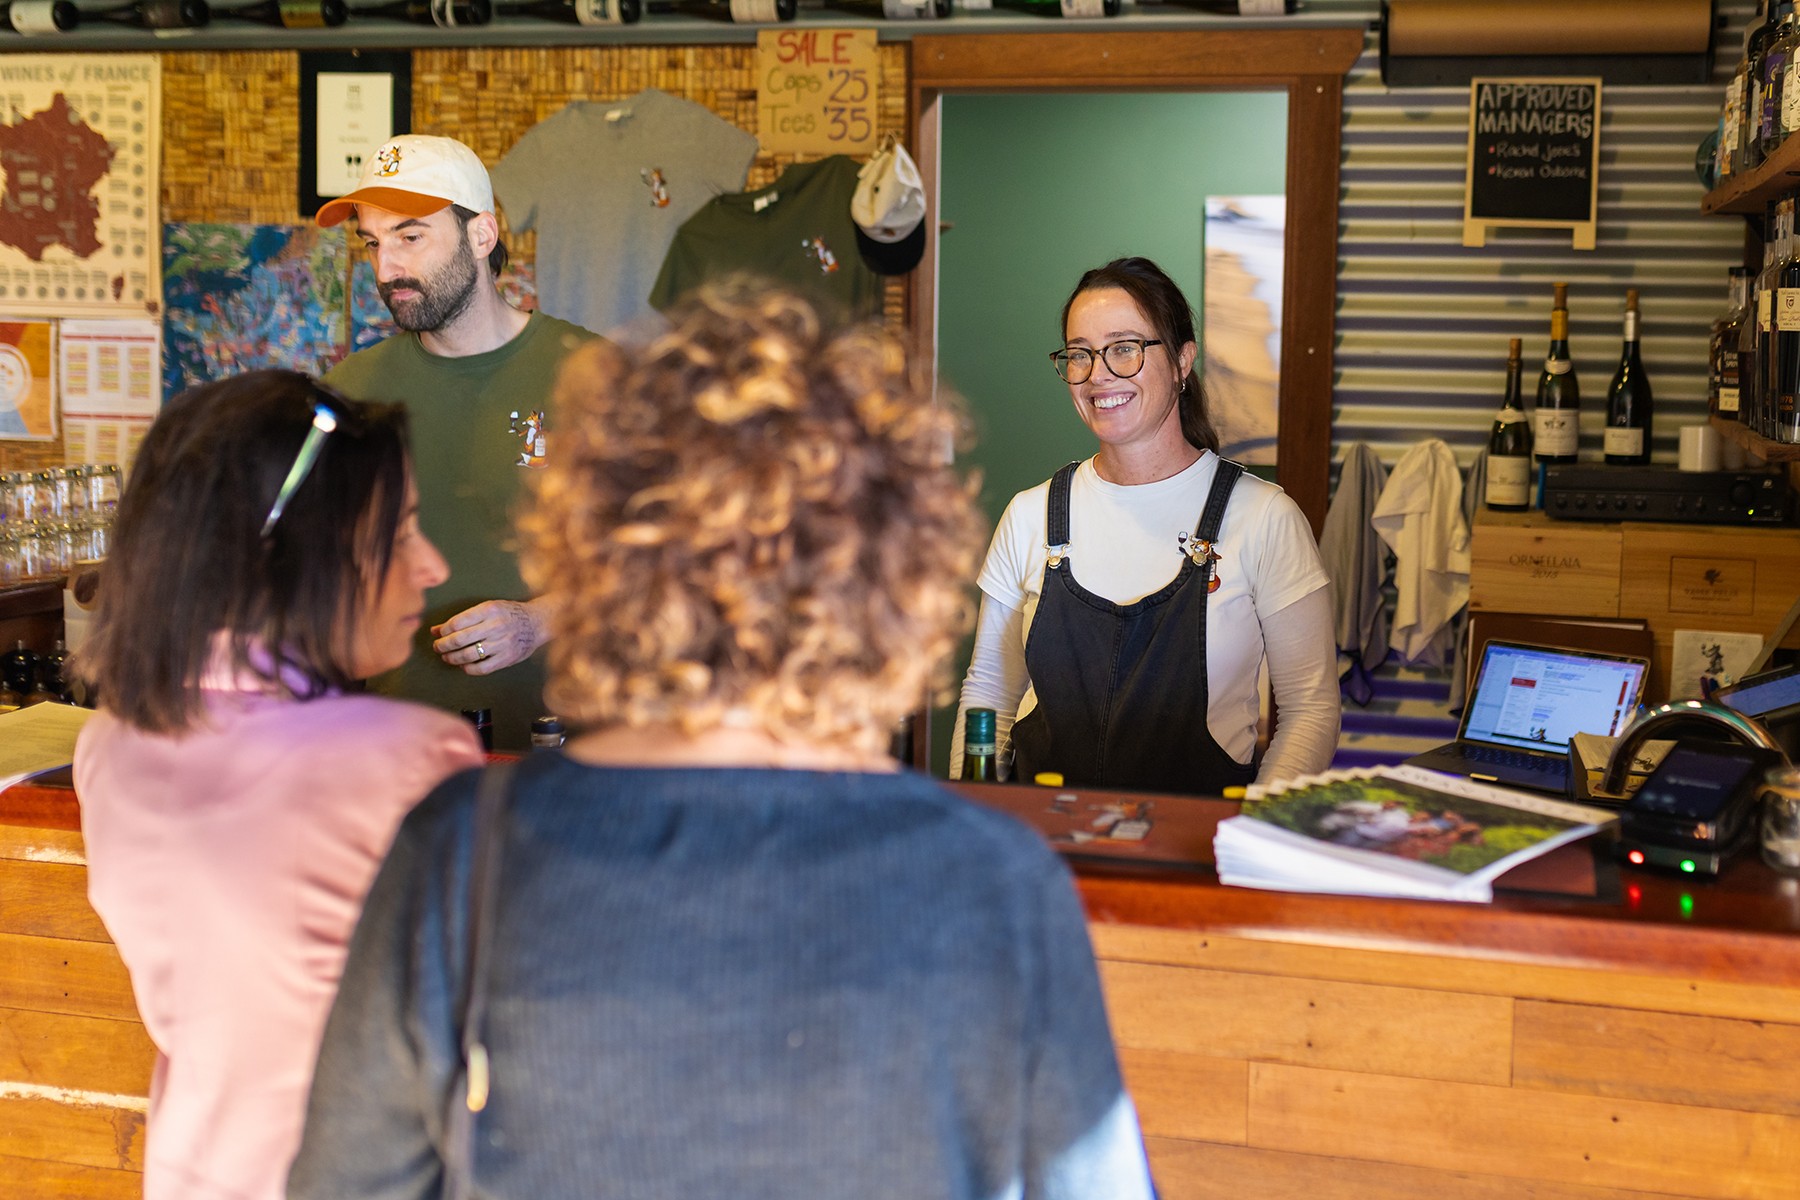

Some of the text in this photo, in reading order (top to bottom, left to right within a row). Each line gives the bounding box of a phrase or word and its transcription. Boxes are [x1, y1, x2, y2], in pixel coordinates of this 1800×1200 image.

[777, 29, 855, 67] SALE
[0, 65, 55, 81] WINES
[83, 64, 151, 81] FRANCE
[766, 66, 822, 103] Caps
[1479, 84, 1594, 110] APPROVED
[762, 104, 817, 135] Tees
[1478, 110, 1593, 138] MANAGERS
